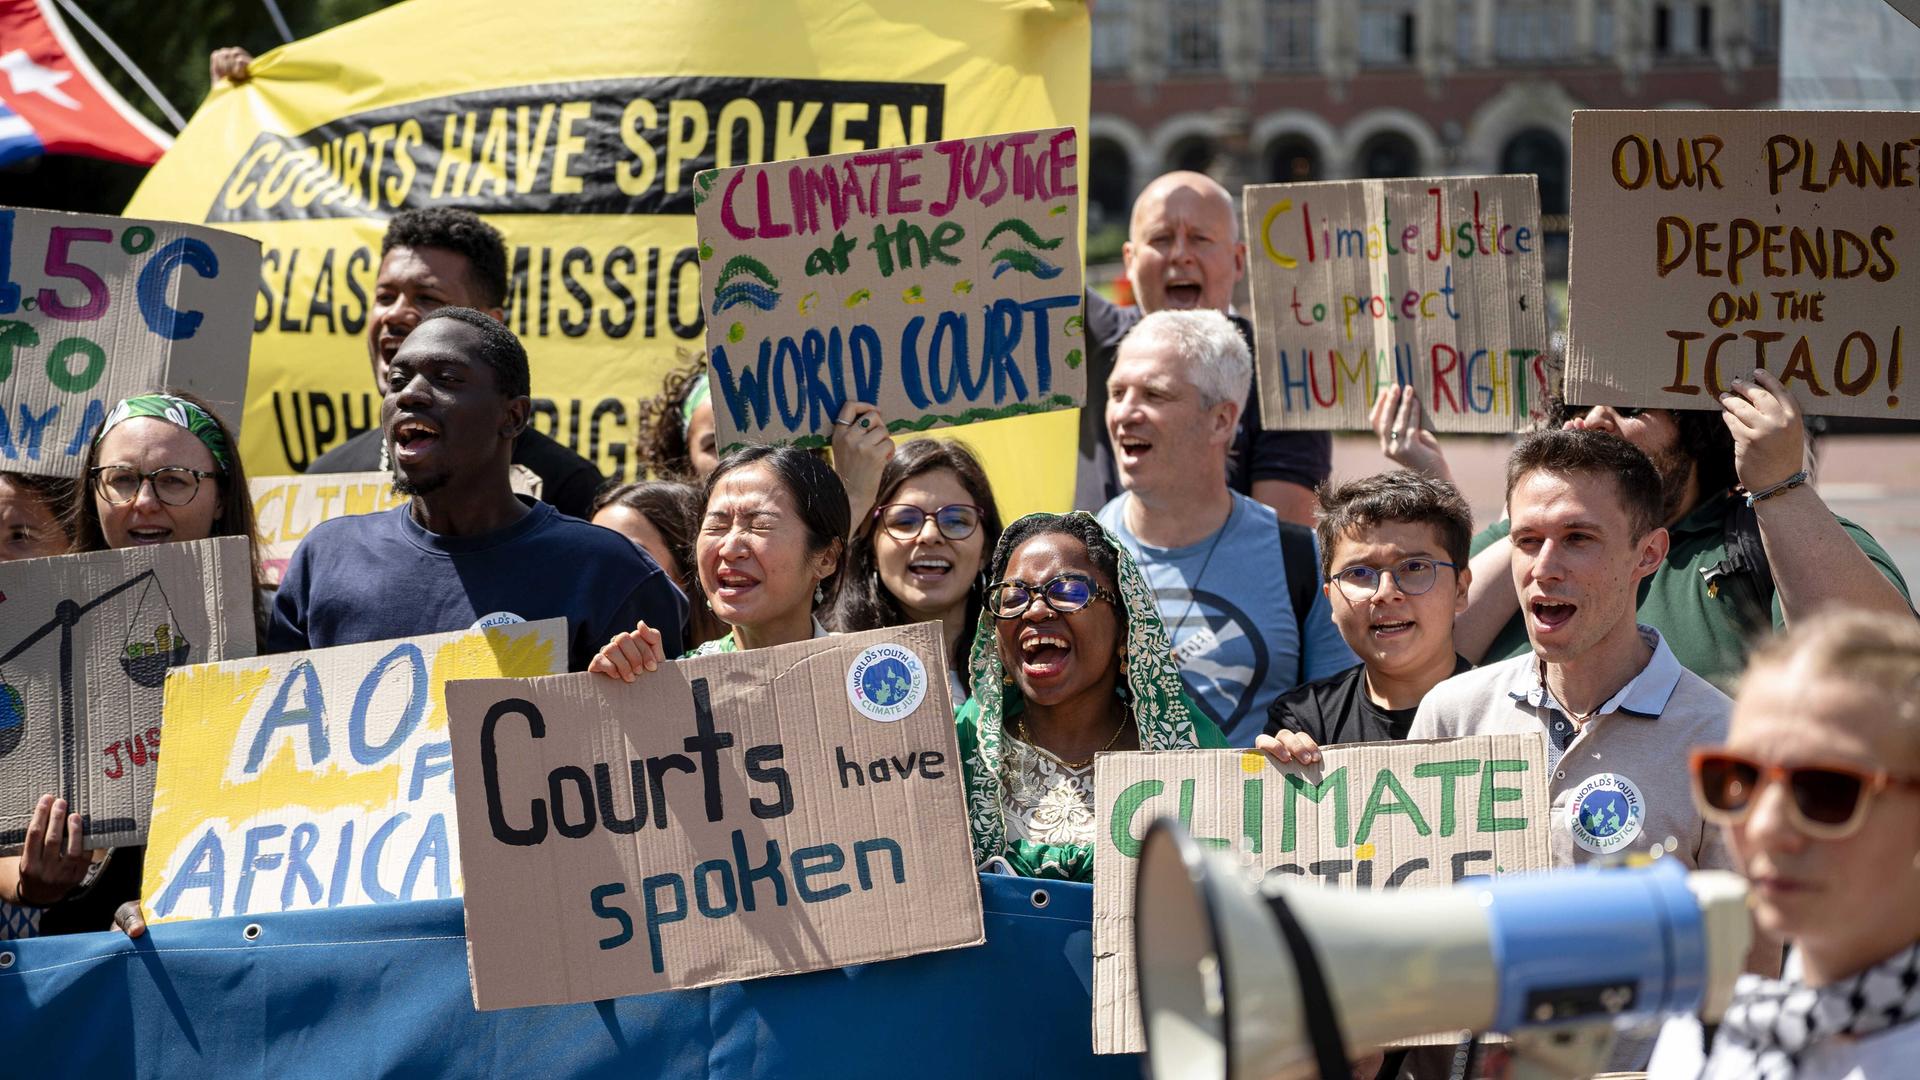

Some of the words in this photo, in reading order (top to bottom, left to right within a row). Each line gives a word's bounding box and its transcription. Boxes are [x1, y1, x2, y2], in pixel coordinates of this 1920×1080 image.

[224, 119, 423, 210] COURTS
[430, 101, 592, 199] HAVE
[721, 149, 923, 240] CLIMATE
[929, 128, 1078, 217] JUSTICE
[1612, 132, 1725, 192] OUR
[804, 230, 858, 277] at
[868, 219, 966, 277] the
[1261, 196, 1419, 269] Climate
[1427, 188, 1532, 261] Justice
[1656, 216, 1898, 287] DEPENDS
[254, 246, 372, 334] SLAS
[503, 245, 706, 339] MISSIO
[1291, 286, 1327, 326] to
[1343, 265, 1460, 340] protect
[1707, 290, 1763, 328] ON
[1770, 289, 1827, 323] THE
[0, 320, 107, 394] TO
[900, 295, 1081, 410] COURT
[1280, 344, 1413, 412] HUMAN
[273, 391, 370, 474] UPH
[877, 648, 910, 663] YOUTH
[243, 642, 430, 774] AO
[861, 700, 903, 716] CLIMATE
[902, 673, 921, 710] JUSTICE
[103, 727, 162, 779] JUS
[480, 677, 795, 847] Courts
[836, 745, 946, 789] have
[1613, 779, 1638, 805] YOUTH
[152, 811, 453, 919] AFRICA
[1570, 818, 1601, 847] CLIMATE
[1602, 820, 1636, 848] JUSTICE
[590, 830, 906, 974] spoken
